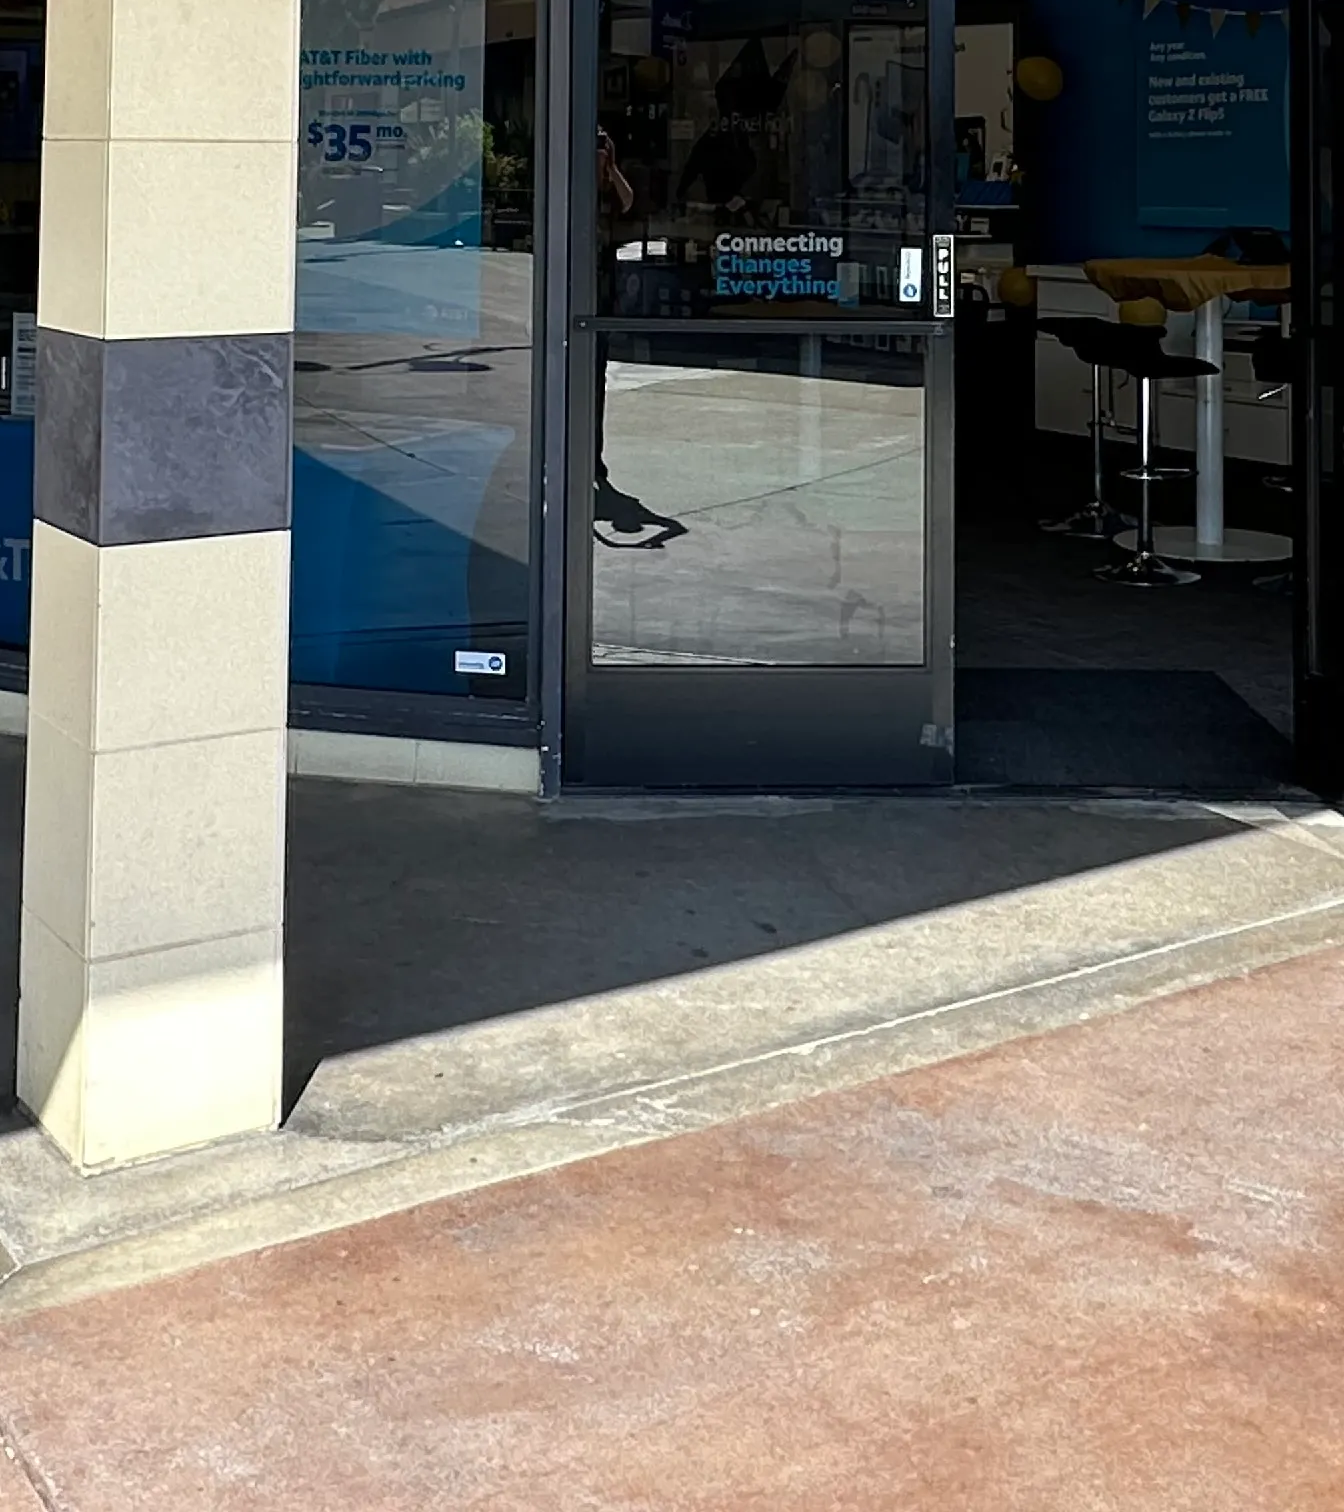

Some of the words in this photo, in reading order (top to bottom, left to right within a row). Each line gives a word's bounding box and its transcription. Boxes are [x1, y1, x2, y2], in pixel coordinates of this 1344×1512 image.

[345, 49, 386, 65] Fiber
[393, 49, 432, 65] with
[1239, 88, 1269, 102] FREE
[307, 119, 372, 162] $35
[715, 231, 843, 258] Connecting
[715, 254, 812, 278] Changes
[937, 248, 949, 300] PULL
[715, 274, 841, 300] Everything
